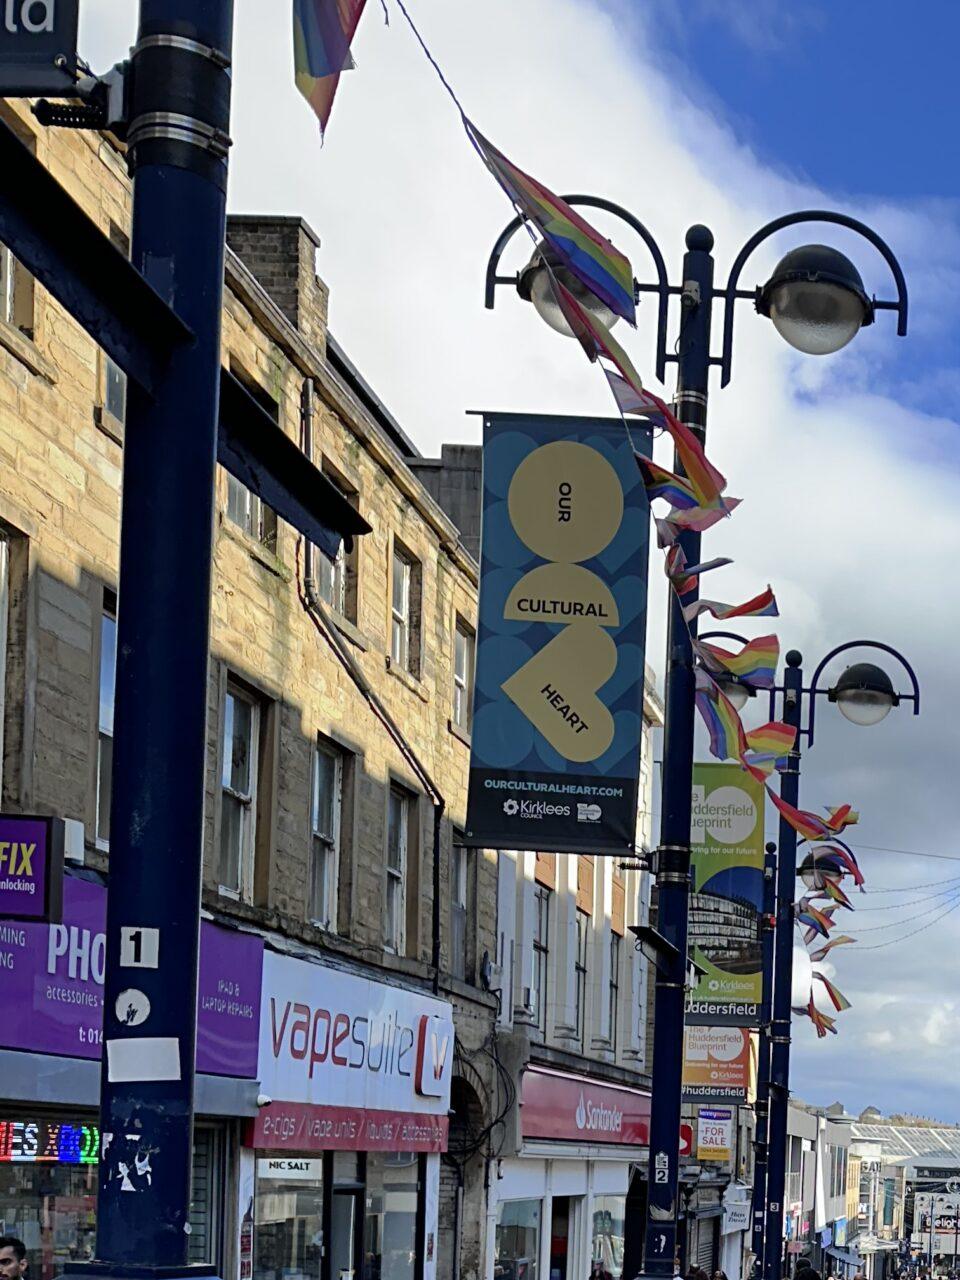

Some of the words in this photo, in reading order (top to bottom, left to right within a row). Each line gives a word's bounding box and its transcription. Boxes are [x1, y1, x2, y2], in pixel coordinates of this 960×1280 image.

[558, 482, 572, 522] OUR
[517, 598, 608, 617] CULTURAL
[540, 683, 589, 734] HEART
[484, 779, 623, 797] OURCULTURALHEART.COM
[520, 800, 571, 816] Kirklees
[691, 804, 753, 816] ddersfield
[0, 842, 36, 876] FIX
[710, 847, 721, 855] for
[47, 923, 107, 985] PHO
[129, 931, 143, 963] 1
[46, 984, 99, 1008] accessories
[217, 979, 234, 996] IPAD
[234, 983, 240, 997] &
[202, 995, 227, 1013] LAPTOP
[227, 1001, 254, 1019] REPAIRS
[688, 1033, 742, 1043] Huddersfield
[688, 1041, 726, 1051] Blueprint
[586, 1099, 622, 1132] Santander
[263, 1113, 297, 1141] e-cigs
[705, 1126, 724, 1136] FOR
[702, 1136, 727, 1146] SALE
[269, 1160, 286, 1170] NIC
[287, 1162, 311, 1172] SALT
[657, 1170, 666, 1182] 2
[771, 1203, 778, 1211] 3
